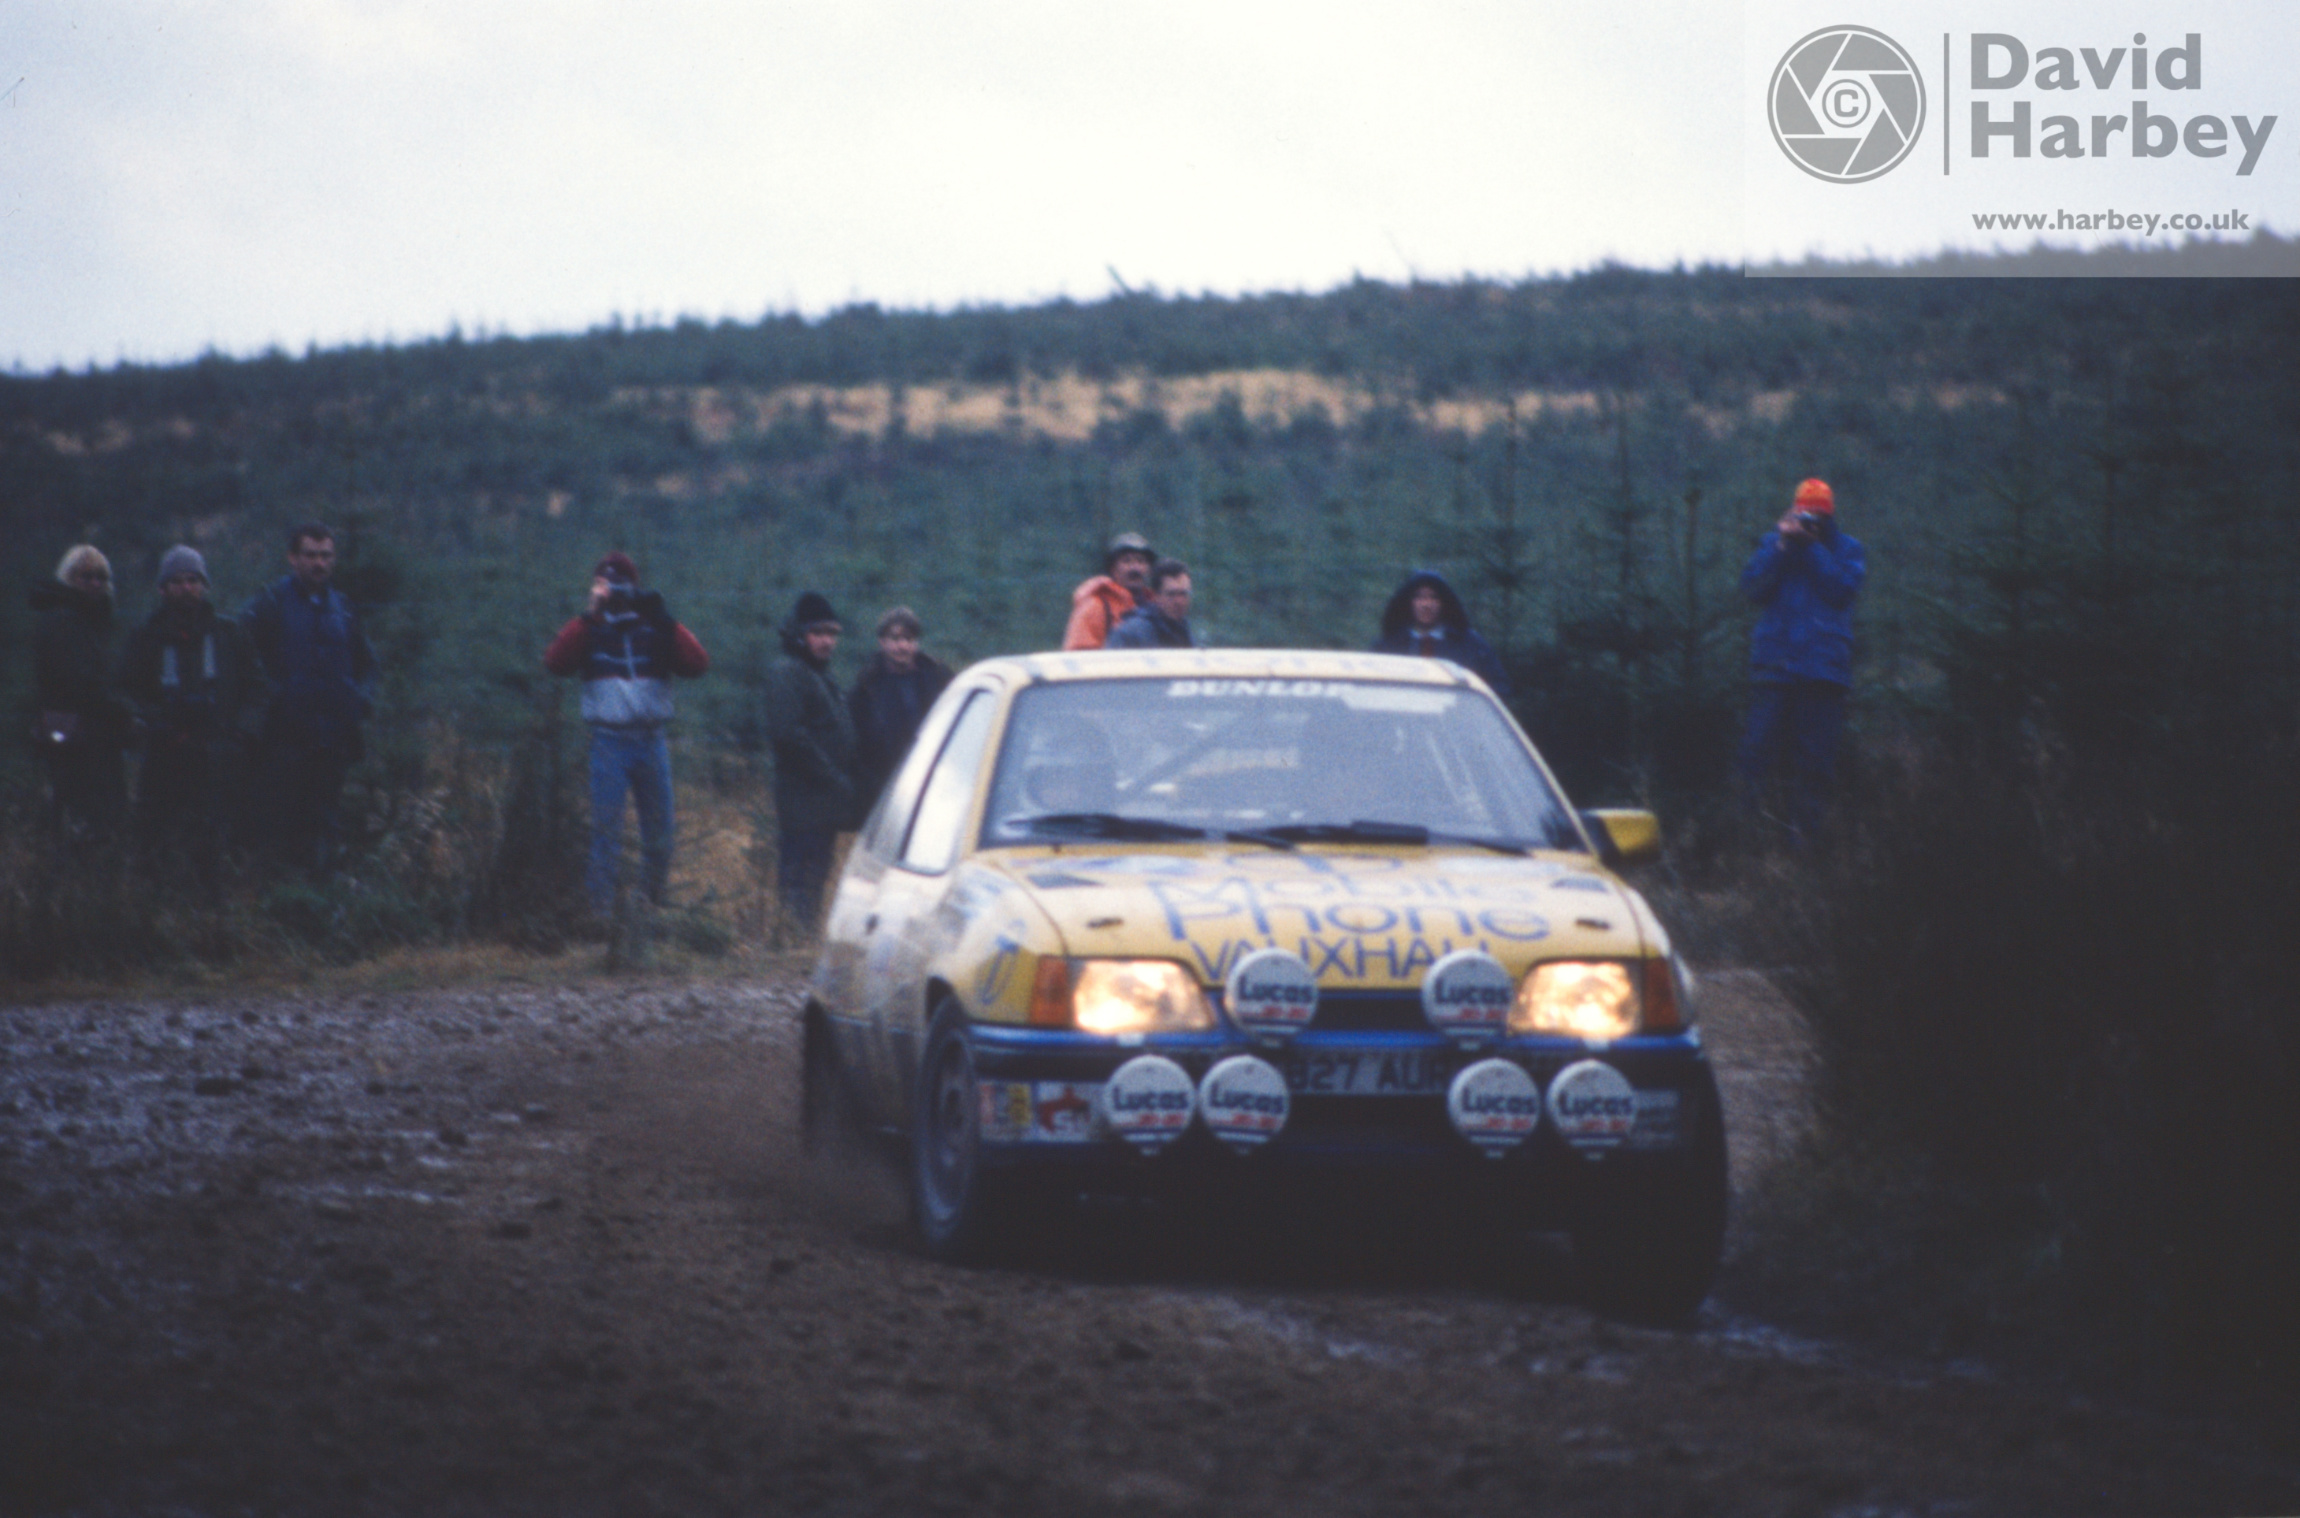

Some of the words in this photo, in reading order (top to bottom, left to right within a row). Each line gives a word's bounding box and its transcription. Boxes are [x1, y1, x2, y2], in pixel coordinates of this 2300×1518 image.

[1166, 678, 1355, 699] DUNLOP
[1158, 893, 1551, 942] Phone
[1238, 973, 1313, 1003] Lucas
[1435, 977, 1510, 1005] Lucas
[1112, 1085, 1189, 1111] Lucas
[1210, 1080, 1284, 1113] Lucas
[1462, 1086, 1536, 1114] Lucas
[1558, 1089, 1632, 1116] Lucas
